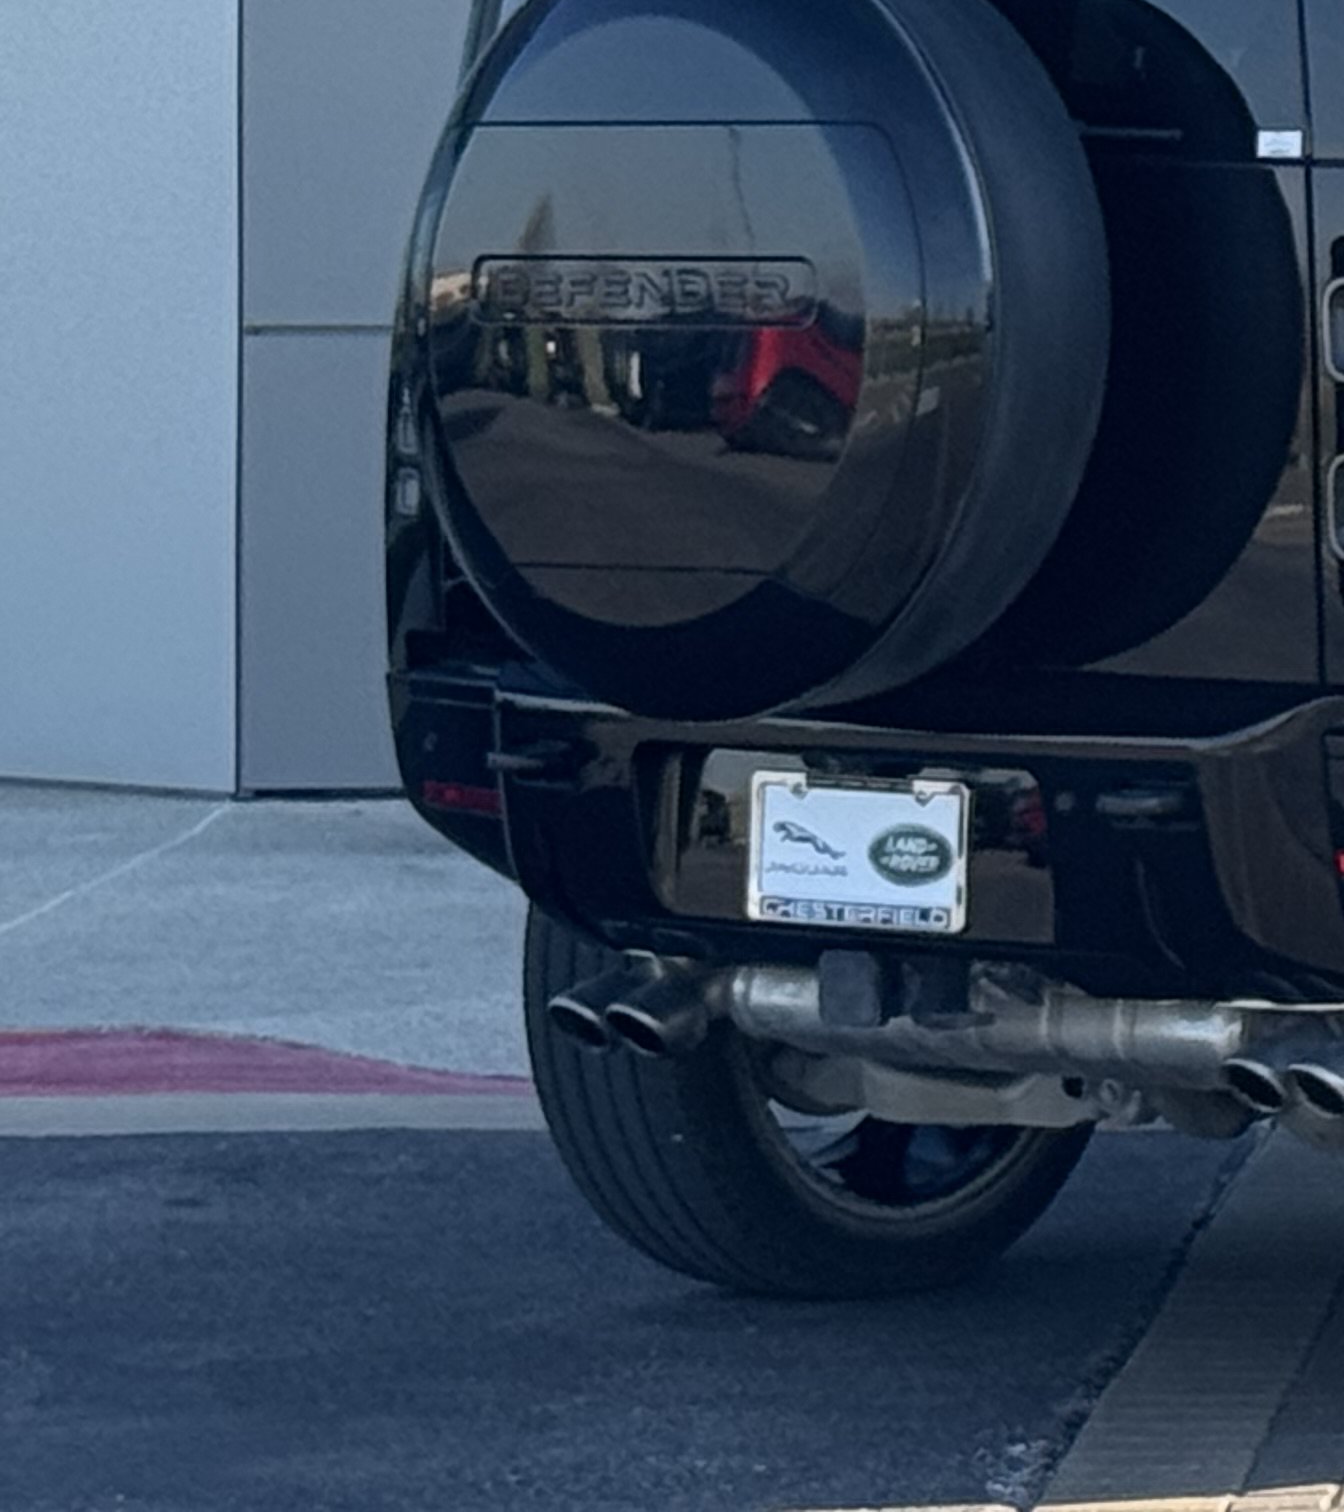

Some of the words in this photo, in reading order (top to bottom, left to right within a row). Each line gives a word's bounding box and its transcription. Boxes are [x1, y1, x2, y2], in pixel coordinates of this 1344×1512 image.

[490, 266, 792, 311] DEFENDER
[885, 835, 931, 854] LAND
[765, 861, 849, 877] JAGUAR
[888, 854, 941, 873] ROVER
[763, 899, 949, 925] CHESTERFIELD
